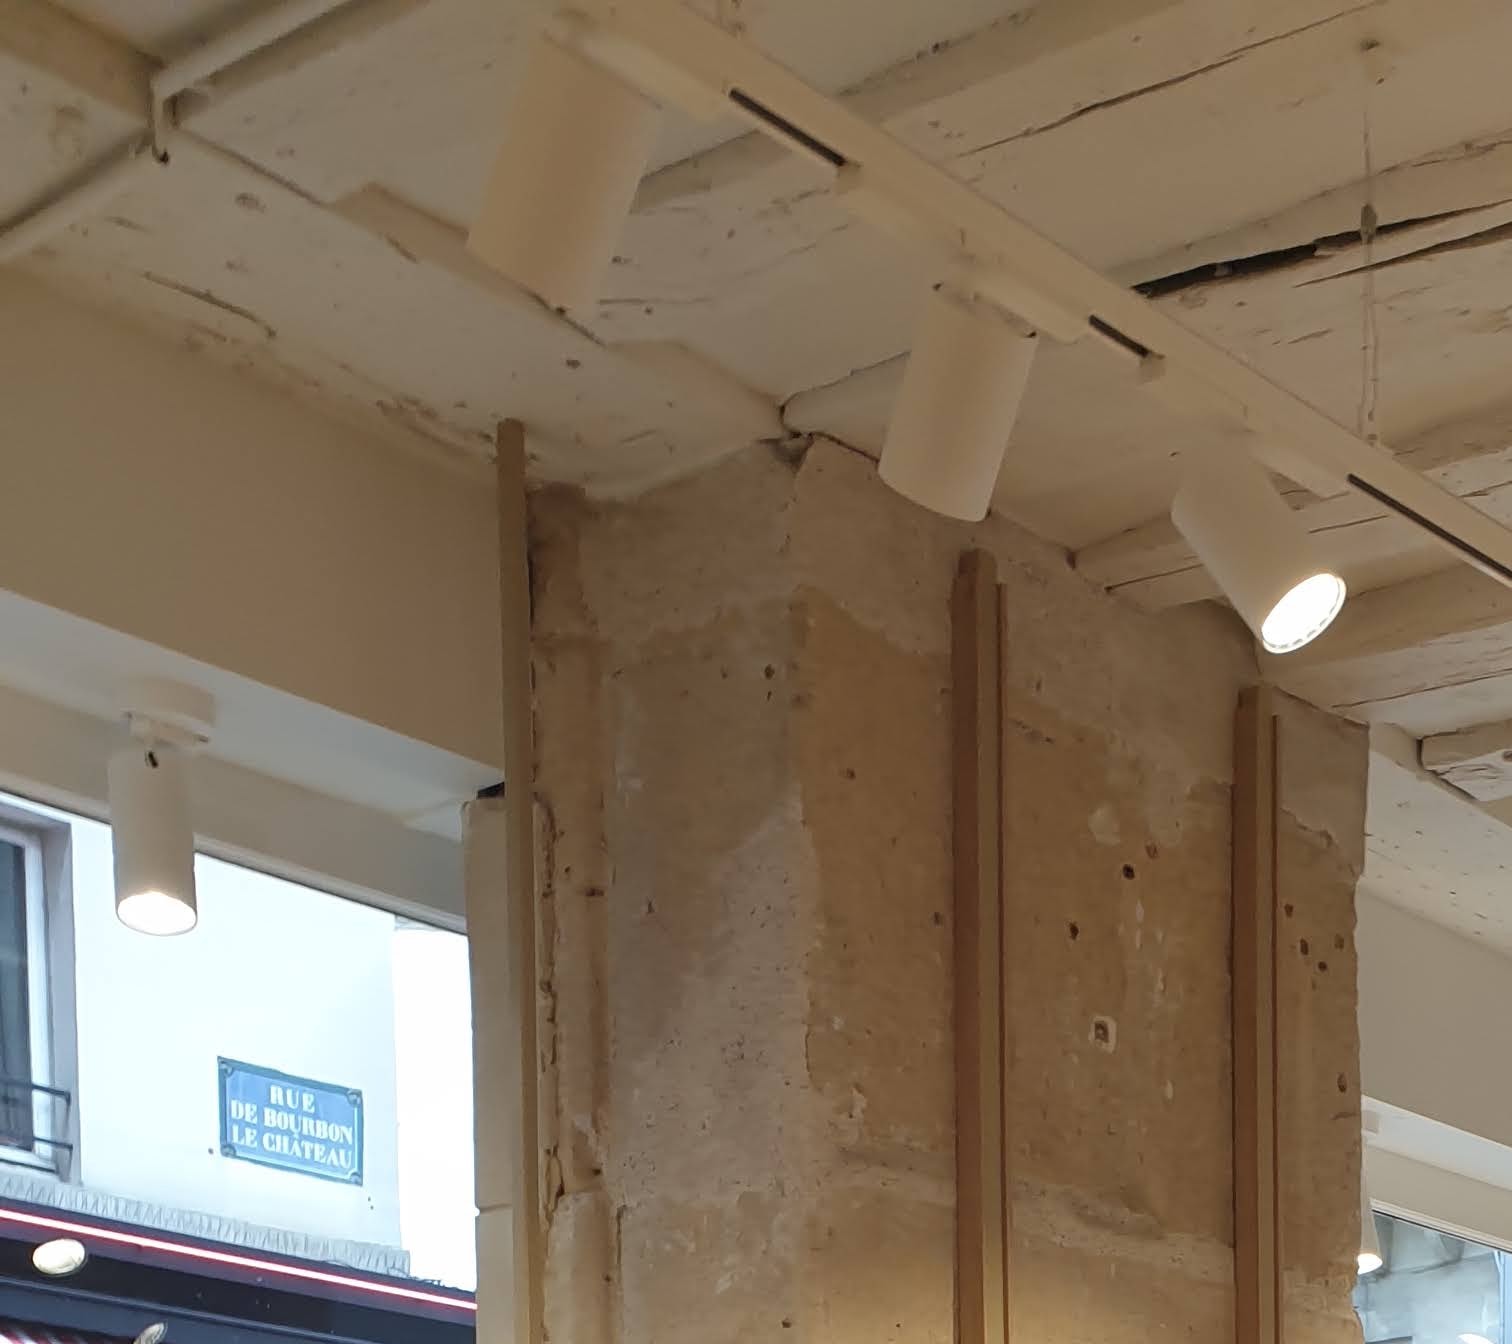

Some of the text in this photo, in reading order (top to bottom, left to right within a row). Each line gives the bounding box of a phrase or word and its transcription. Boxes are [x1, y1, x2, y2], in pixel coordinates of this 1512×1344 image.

[270, 1084, 315, 1114] RUE
[230, 1099, 353, 1145] DE BOURBON
[231, 1124, 352, 1169] LE CHÂTEAU
